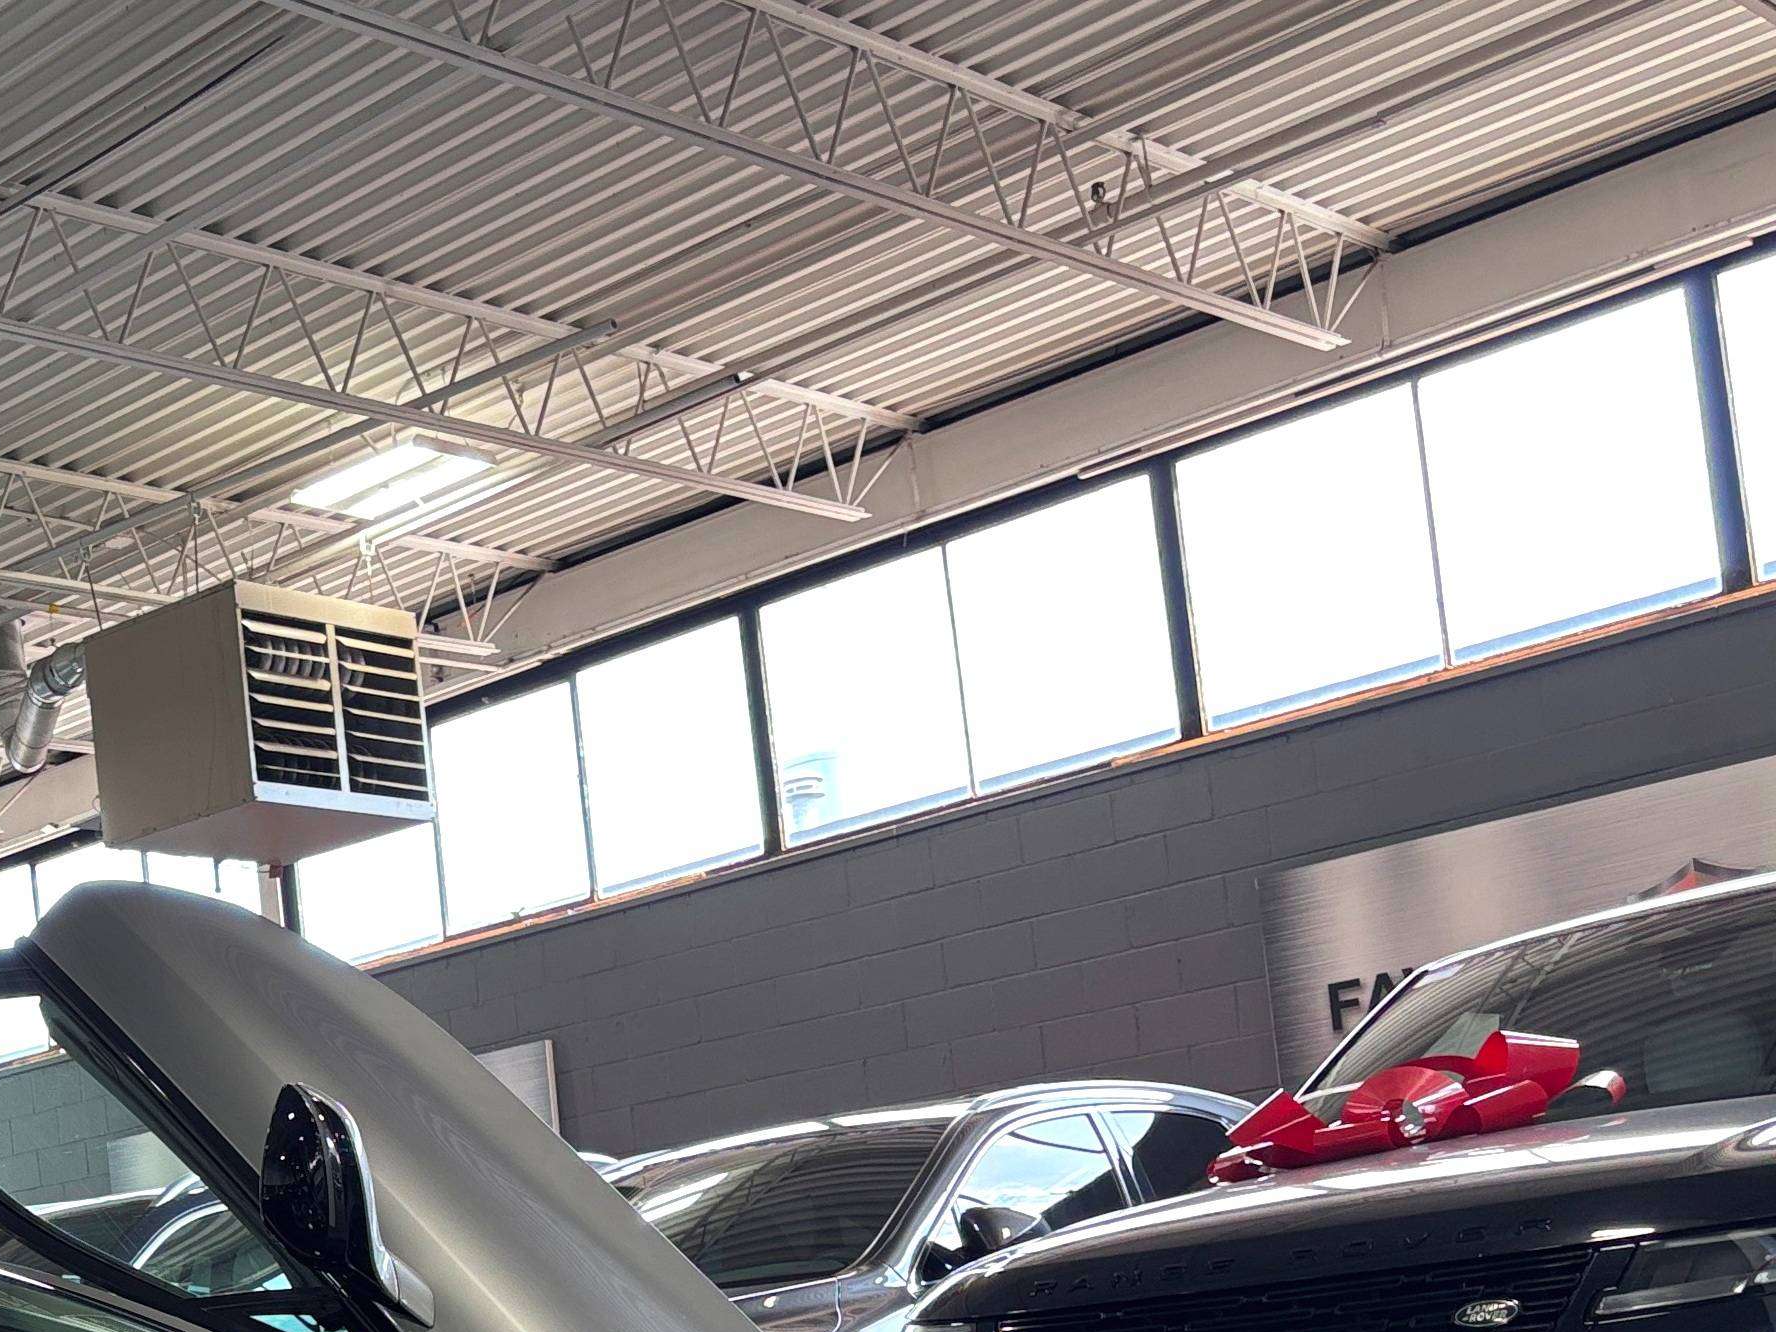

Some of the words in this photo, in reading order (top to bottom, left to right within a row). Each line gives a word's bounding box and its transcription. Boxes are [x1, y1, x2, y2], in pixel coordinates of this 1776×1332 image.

[1030, 1259, 1235, 1297] RANGE
[1290, 1218, 1551, 1263] ROVER
[1466, 1303, 1500, 1315] LAND
